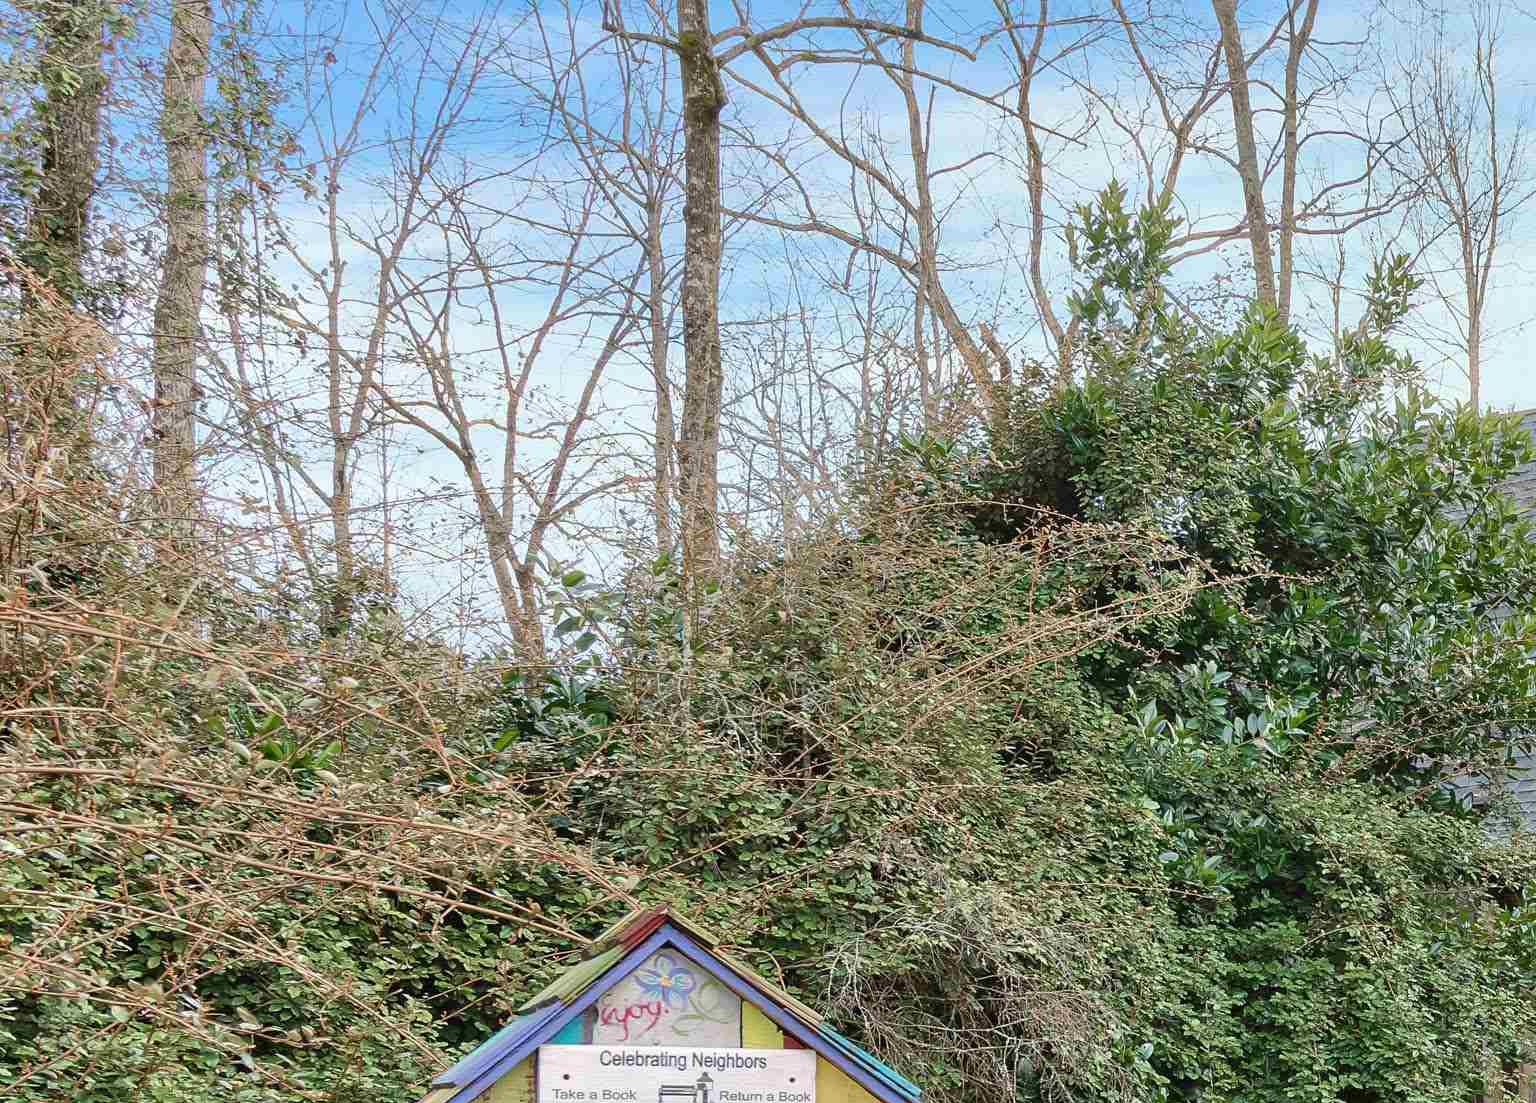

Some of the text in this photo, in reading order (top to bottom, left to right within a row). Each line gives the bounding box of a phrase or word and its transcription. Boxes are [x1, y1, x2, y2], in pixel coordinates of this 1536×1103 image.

[599, 1050, 768, 1071] Celebrating Neighbors
[552, 1088, 637, 1101] Take a Book
[719, 1090, 811, 1103] Return a Book
